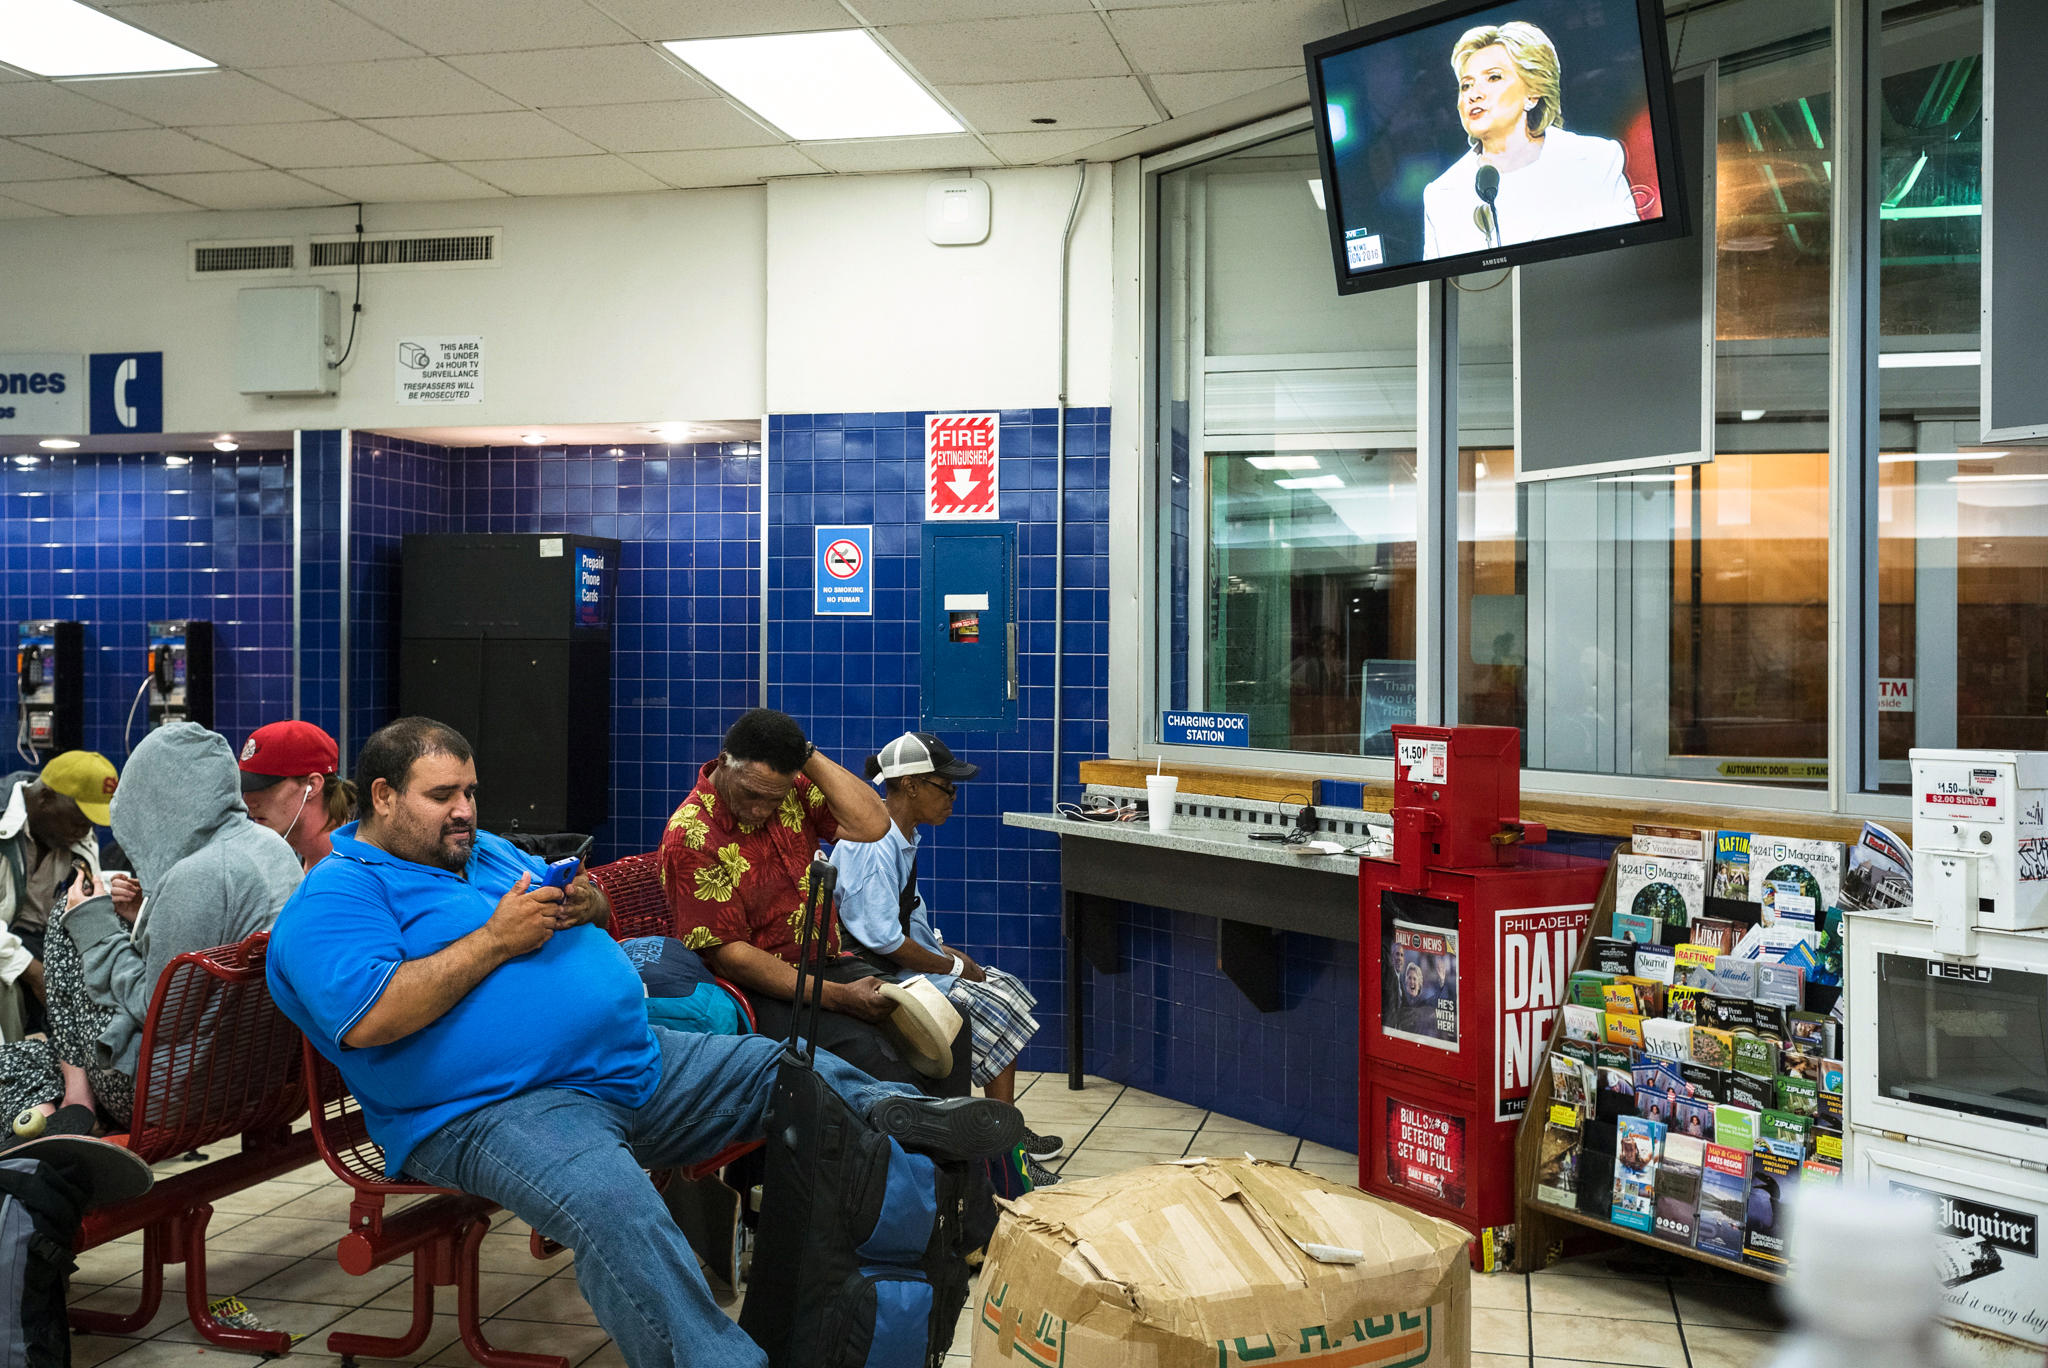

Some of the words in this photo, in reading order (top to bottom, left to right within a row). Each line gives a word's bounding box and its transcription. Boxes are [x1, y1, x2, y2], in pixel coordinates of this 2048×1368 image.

[1362, 249, 1379, 262] 2016
[1482, 257, 1508, 267] SAMSUNG
[440, 343, 457, 351] THIS
[458, 343, 479, 351] AREA
[443, 352, 451, 360] IS
[452, 352, 479, 360] UNDER
[445, 361, 467, 369] HOUR
[422, 369, 479, 378] SURVEILLANCE
[403, 382, 456, 390] TRESPASSERS
[420, 391, 470, 399] PROSECUTED
[939, 429, 987, 447] FIRE
[937, 450, 988, 466] EXTINGUISHER
[582, 554, 604, 571] Prepaid
[582, 571, 600, 586] Phone
[581, 588, 599, 602] Cards
[1384, 680, 1414, 691] Than
[1879, 681, 1908, 697] TM
[1380, 695, 1403, 705] you
[1167, 715, 1215, 728] CHARGING
[1217, 717, 1244, 729] DOCK
[1186, 729, 1225, 742] STATION
[1401, 746, 1422, 760] $1.50
[1433, 757, 1444, 767] DAILY
[1433, 766, 1444, 776] NEWS
[1726, 765, 1767, 775] AUTOMATIC
[1769, 765, 1789, 775] DOOR
[1938, 782, 1958, 793] $1.50
[1932, 794, 1955, 804] $2.00
[1956, 796, 1989, 806] SUNDAY
[1652, 844, 1677, 854] Visitors
[1677, 846, 1698, 856] Guide
[1868, 836, 1887, 852] Real
[1788, 848, 1836, 863] Magazine
[1658, 867, 1700, 881] Magazine
[1395, 931, 1411, 947] DAILY
[1422, 936, 1443, 952] NEWS
[1695, 922, 1723, 948] LURAY
[1678, 950, 1715, 964] RAFTING
[1928, 961, 1991, 982] NERO
[1437, 998, 1454, 1011] HE'S
[1604, 994, 1614, 1002] Six
[1616, 994, 1632, 1004] Flags
[1682, 999, 1696, 1010] BA
[1435, 1008, 1455, 1022] WITH
[1728, 1007, 1742, 1015] Penn
[1756, 1011, 1769, 1021] Penn
[1568, 1016, 1596, 1029] AVALON
[1729, 1014, 1753, 1023] Museum
[1756, 1019, 1779, 1031] Museum
[1437, 1019, 1455, 1033] HER!
[1609, 1023, 1619, 1032] Six
[1622, 1026, 1637, 1036] Flags
[1737, 1049, 1751, 1058] SOUTH
[1751, 1053, 1767, 1061] JERSEY
[1786, 1085, 1815, 1097] ZIPLINES
[1819, 1093, 1842, 1102] ROARING,
[1506, 1100, 1527, 1114] THE
[1718, 1121, 1738, 1132] Spending
[1741, 1126, 1749, 1134] day
[1774, 1119, 1803, 1133] ZIPLINES
[1401, 1124, 1446, 1152] DETECTOR
[1817, 1138, 1835, 1148] Crystal
[1398, 1141, 1415, 1160] SET
[1416, 1147, 1428, 1165] ON
[1430, 1151, 1454, 1173] FULL
[1708, 1147, 1721, 1157] Map
[1727, 1152, 1743, 1161] Guide
[1755, 1152, 1778, 1162] ROARING,
[1777, 1156, 1798, 1166] MOVING
[1707, 1155, 1723, 1165] LAKES
[1723, 1157, 1743, 1170] REGION
[1762, 1160, 1790, 1170] DINOSAURS
[1408, 1167, 1422, 1181] DAILY
[1422, 1172, 1438, 1186] NEWS
[1773, 1167, 1787, 1176] HERE!
[1937, 1196, 2033, 1246] Inquirer
[1969, 1296, 1981, 1310] it
[1983, 1302, 2019, 1325] every
[2022, 1308, 2048, 1334] day
